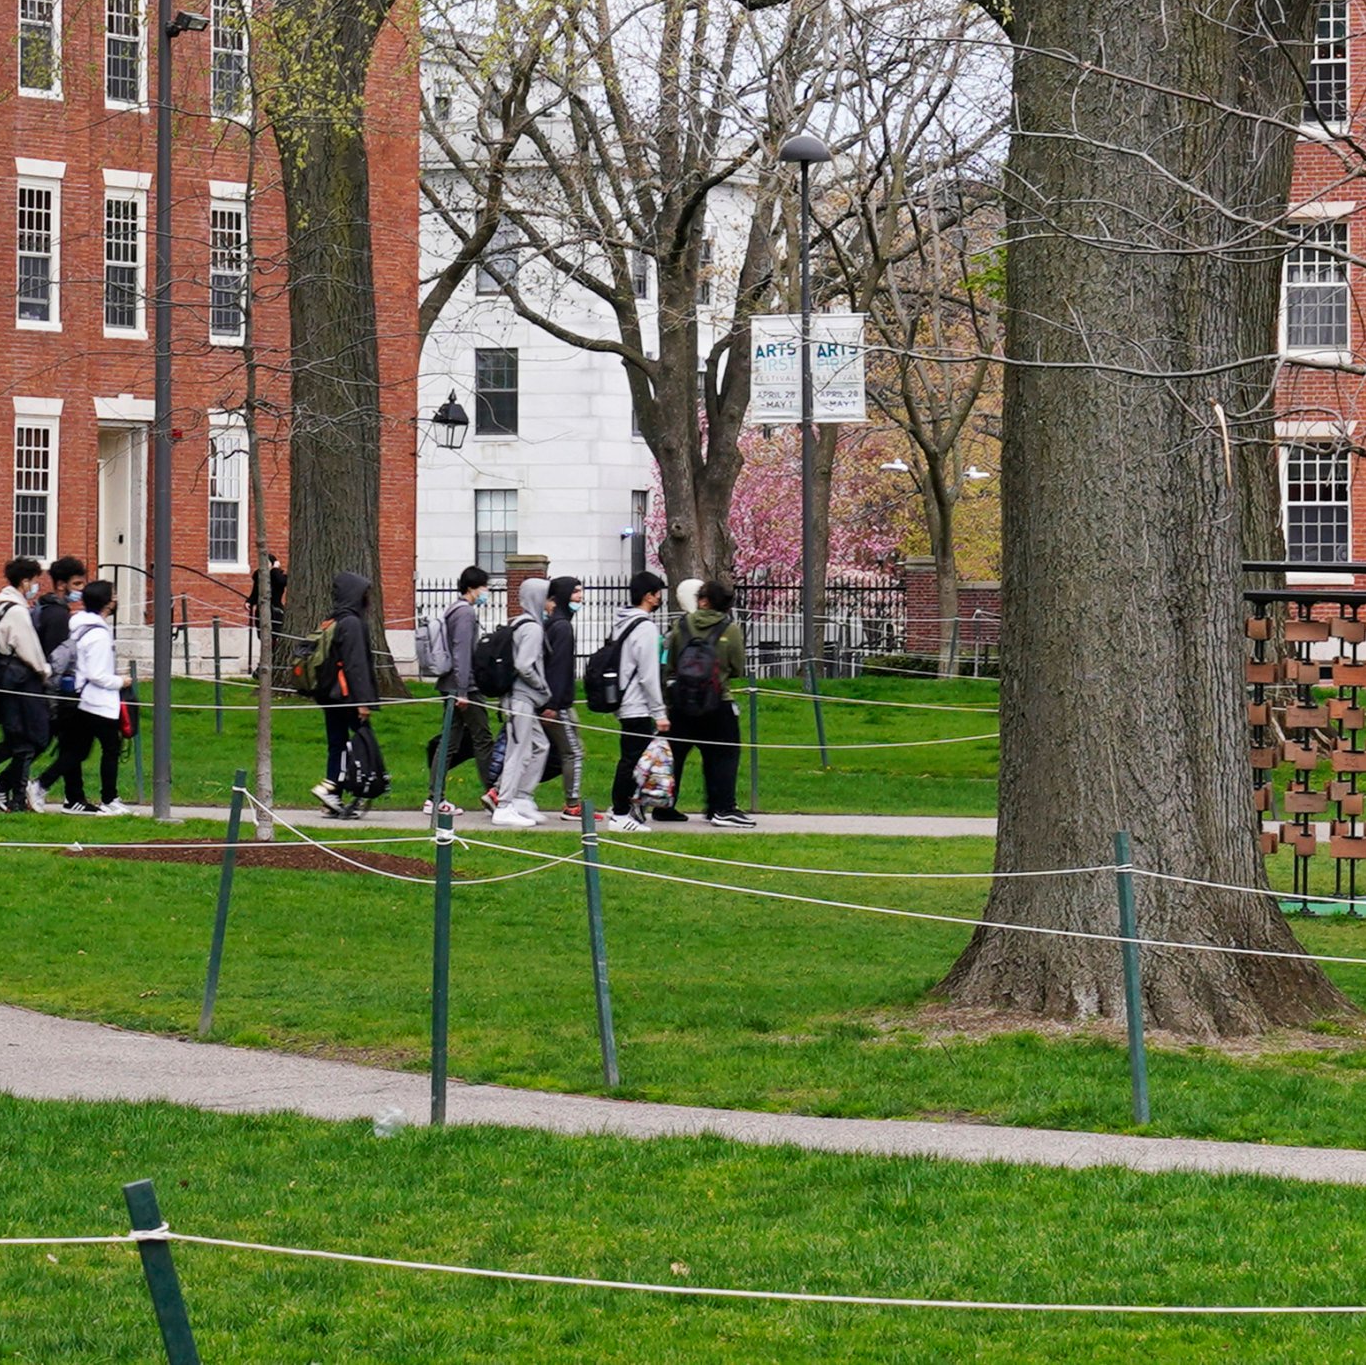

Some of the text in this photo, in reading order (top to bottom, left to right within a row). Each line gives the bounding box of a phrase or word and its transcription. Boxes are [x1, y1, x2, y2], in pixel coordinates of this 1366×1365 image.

[756, 342, 797, 359] ARTS
[817, 342, 858, 358] ARTS
[754, 357, 796, 371] FIRST
[756, 391, 782, 399] APRIL
[820, 390, 845, 398] APRIL
